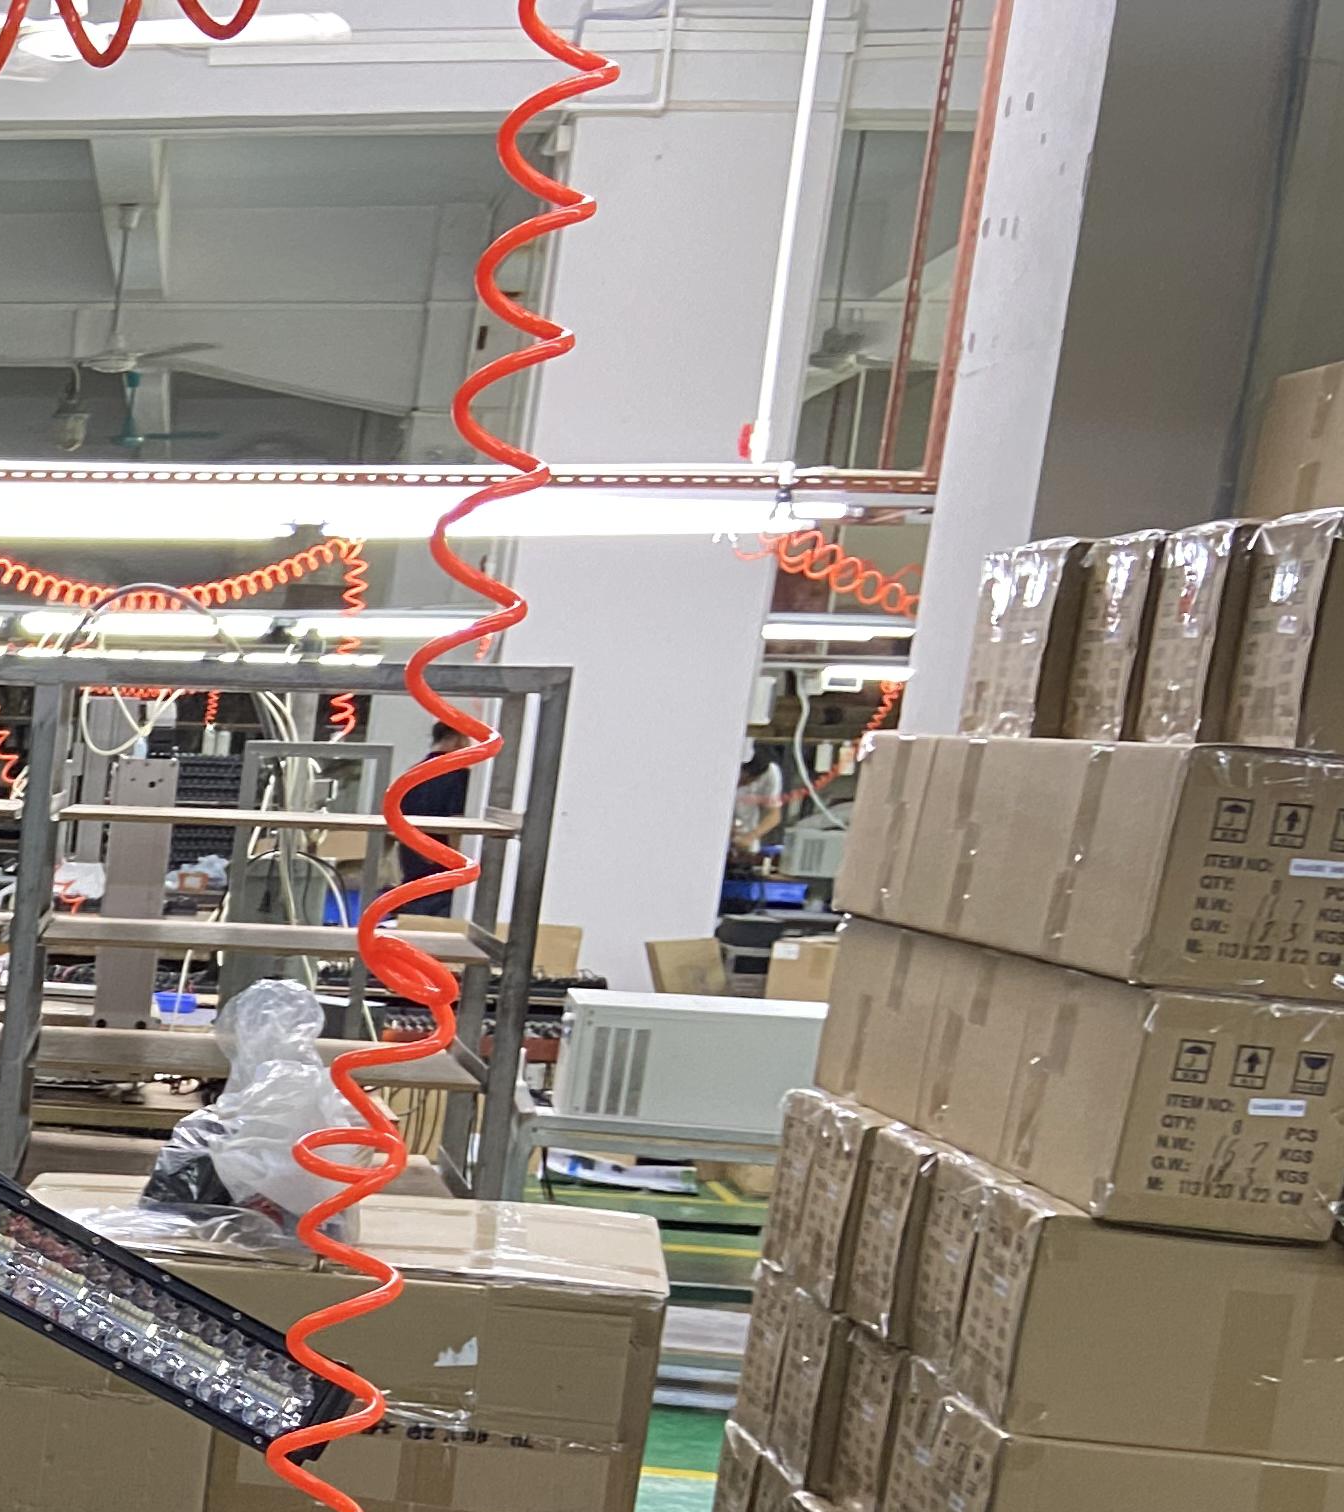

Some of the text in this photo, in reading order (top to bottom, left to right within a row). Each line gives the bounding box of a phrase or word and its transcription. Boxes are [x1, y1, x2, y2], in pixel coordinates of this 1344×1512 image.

[1166, 1093, 1204, 1109] ITEM
[1207, 1097, 1234, 1112] NO:
[1161, 1114, 1196, 1130] QTY:
[1279, 1148, 1315, 1164] KGS
[1276, 1169, 1310, 1185] KGS
